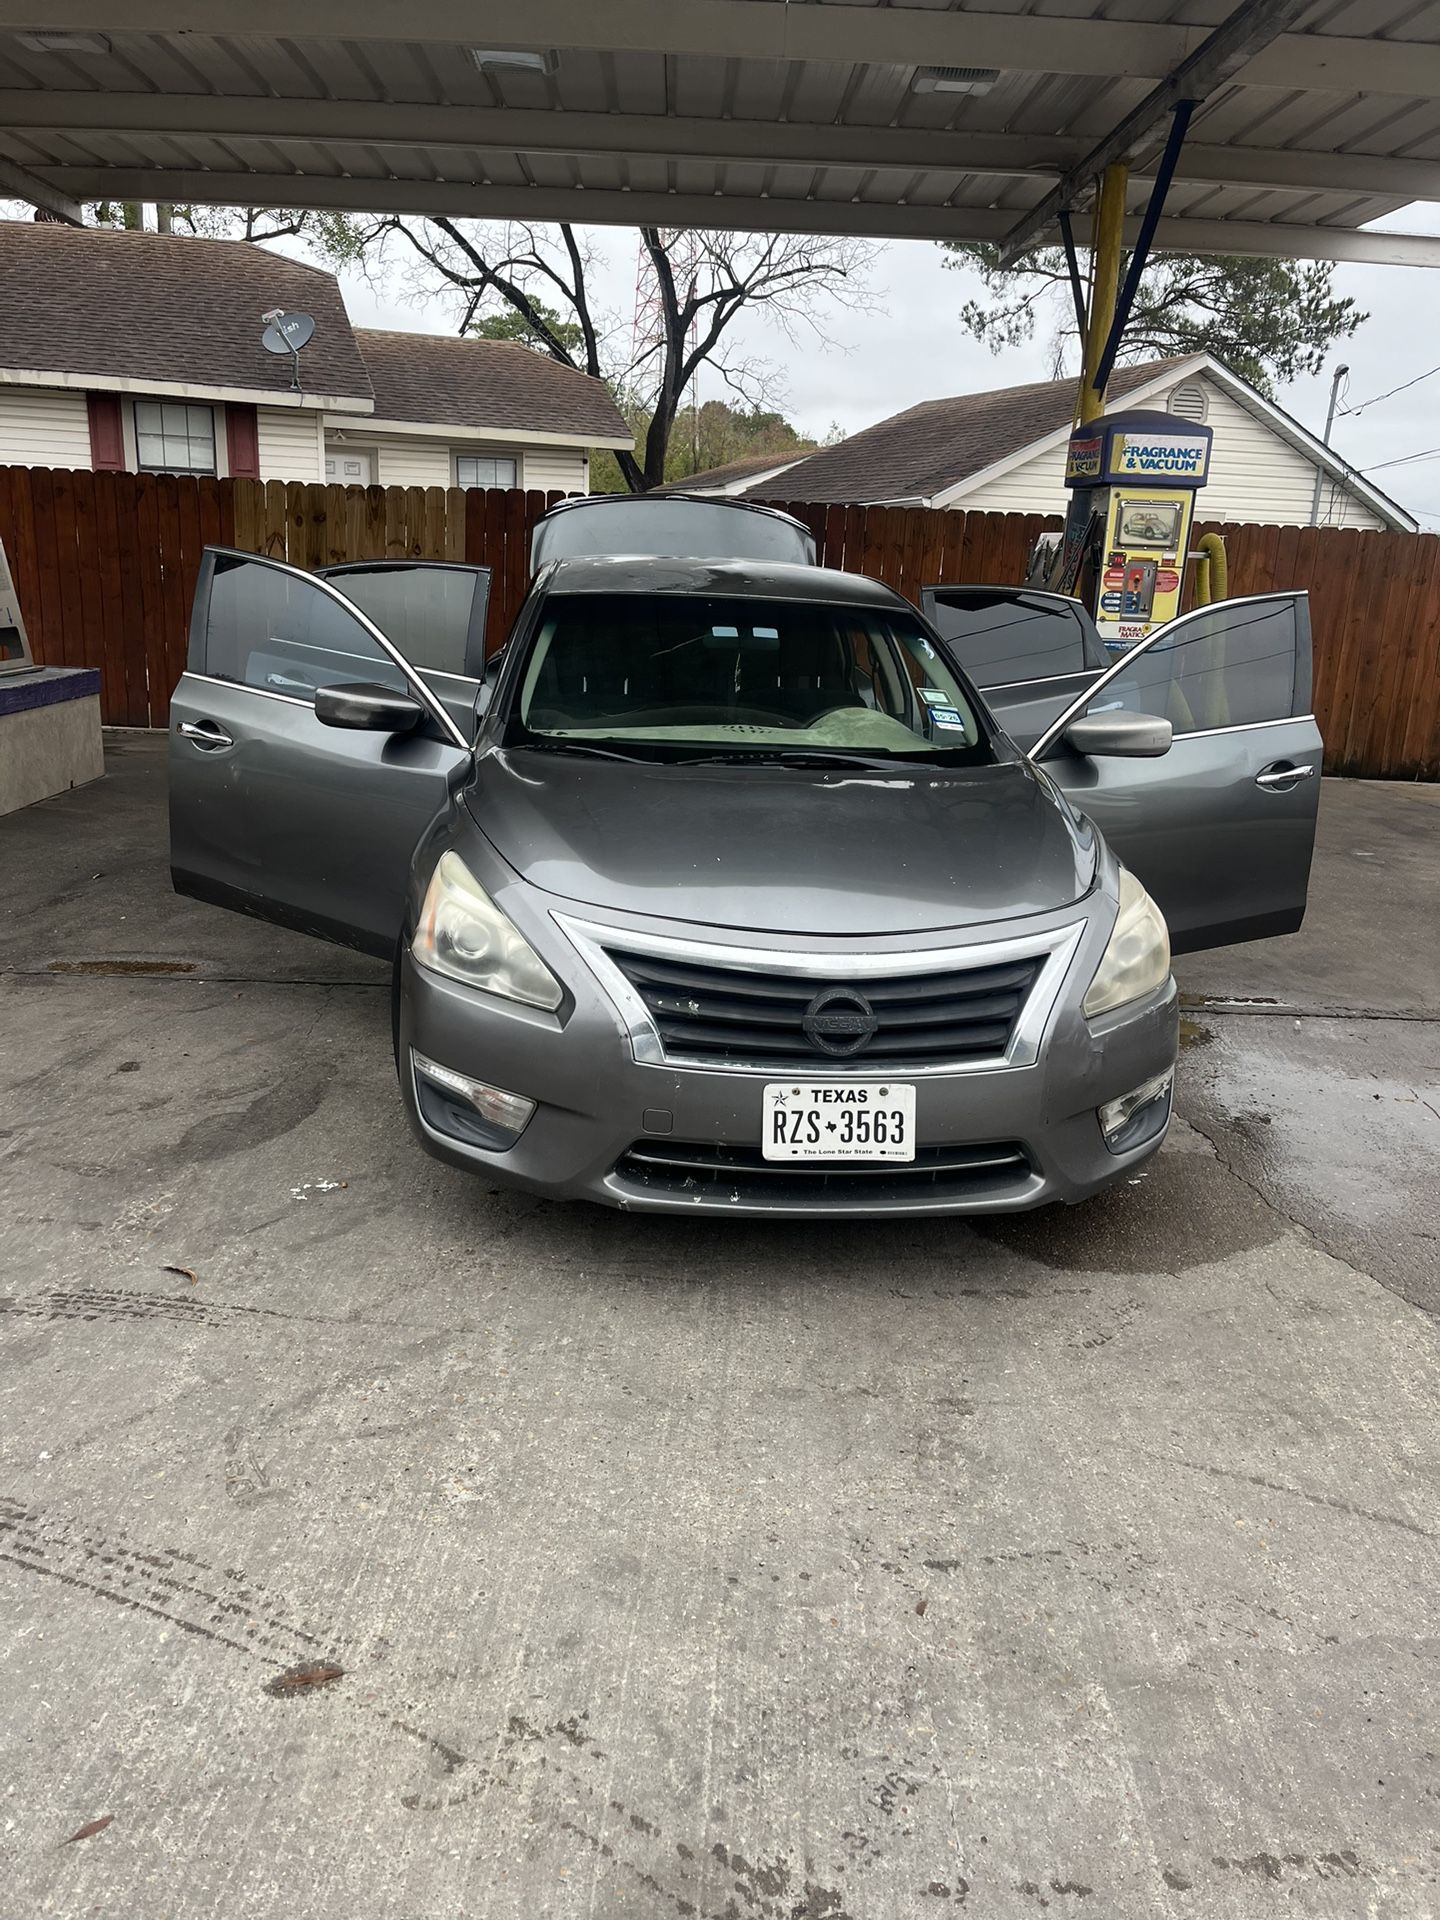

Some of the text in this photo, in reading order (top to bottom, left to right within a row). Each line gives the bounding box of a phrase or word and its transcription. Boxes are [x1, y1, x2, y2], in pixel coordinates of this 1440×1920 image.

[1122, 446, 1202, 460] FRAGRANCE
[1126, 458, 1197, 471] & VACUUM
[811, 1089, 868, 1103] TEXAS
[773, 1110, 904, 1144] RZS 3563
